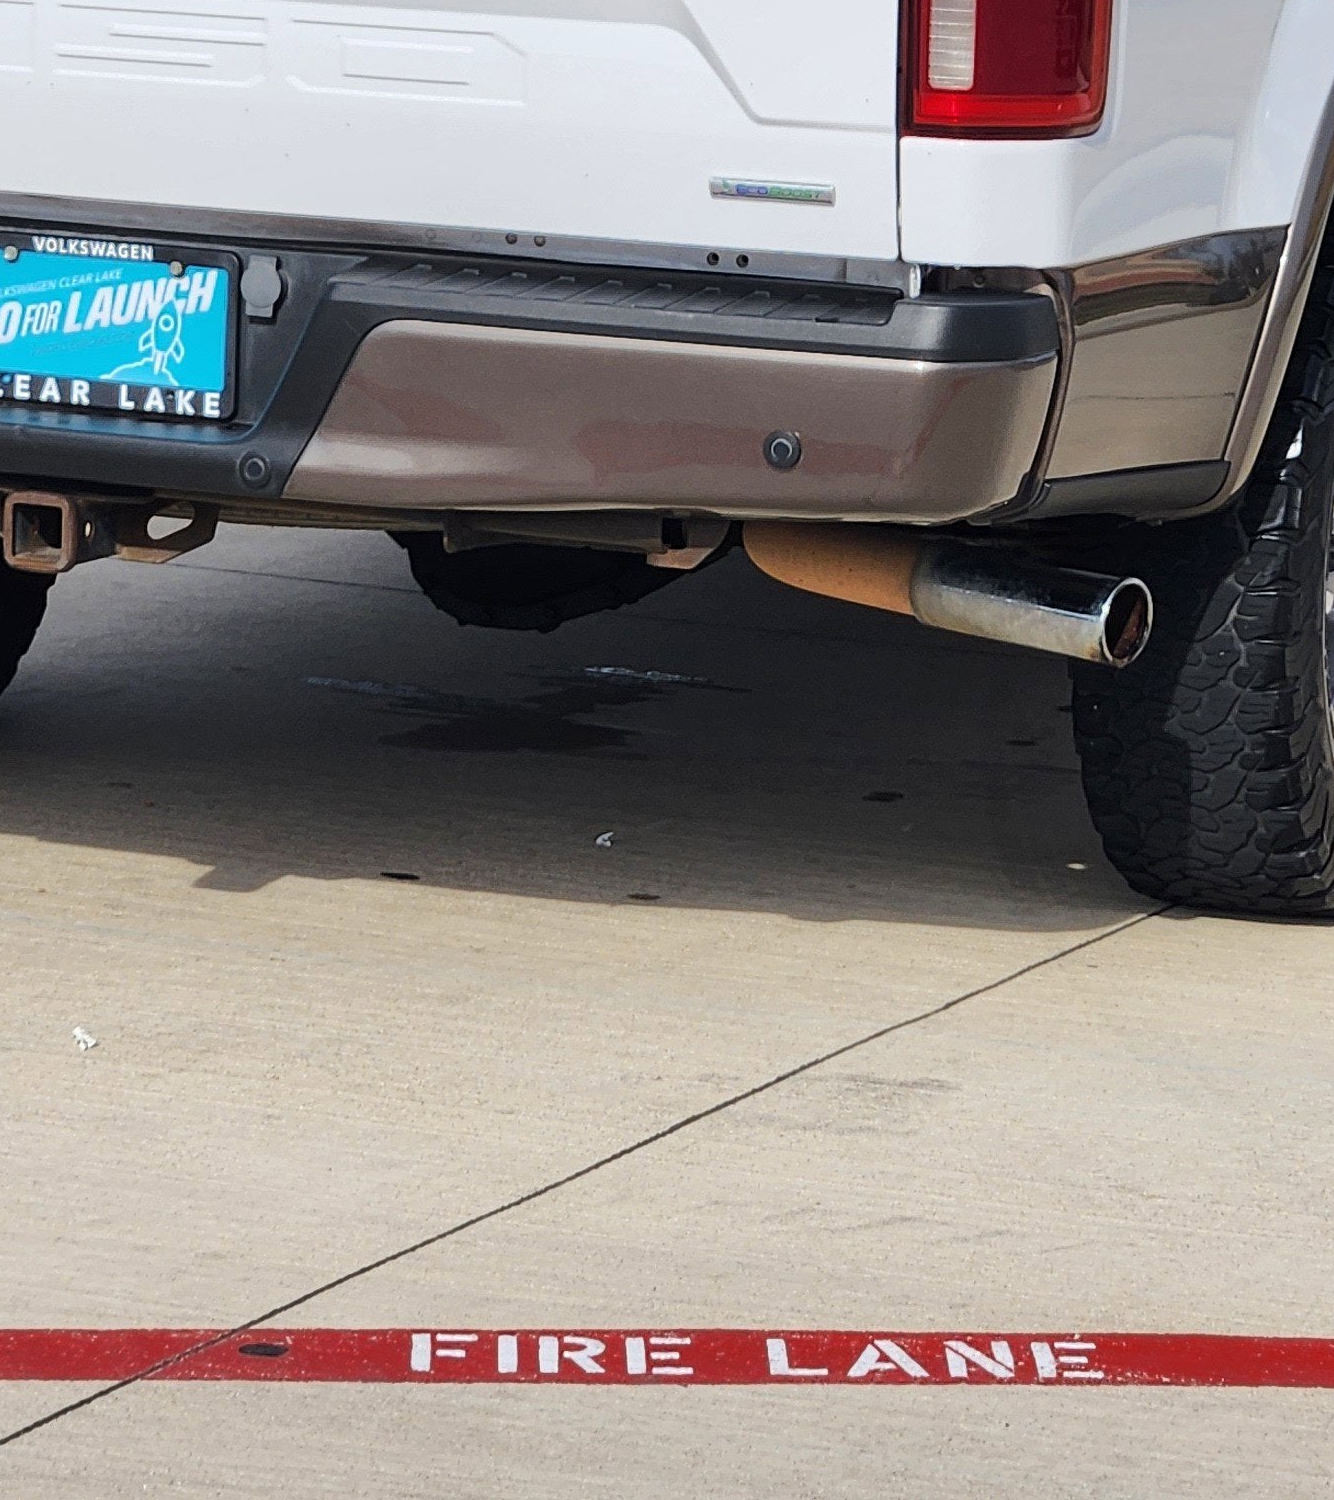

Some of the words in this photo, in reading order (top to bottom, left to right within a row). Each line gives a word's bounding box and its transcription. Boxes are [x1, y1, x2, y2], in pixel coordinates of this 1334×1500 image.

[32, 236, 155, 261] VOLKSWAGEN
[58, 274, 94, 288] CLEAR
[97, 268, 124, 283] LAKE
[20, 300, 63, 338] FOR
[62, 268, 218, 334] LAUNCH
[116, 383, 222, 419] LAKE
[409, 1331, 694, 1377] FIRE
[766, 1335, 1104, 1381] LANE
